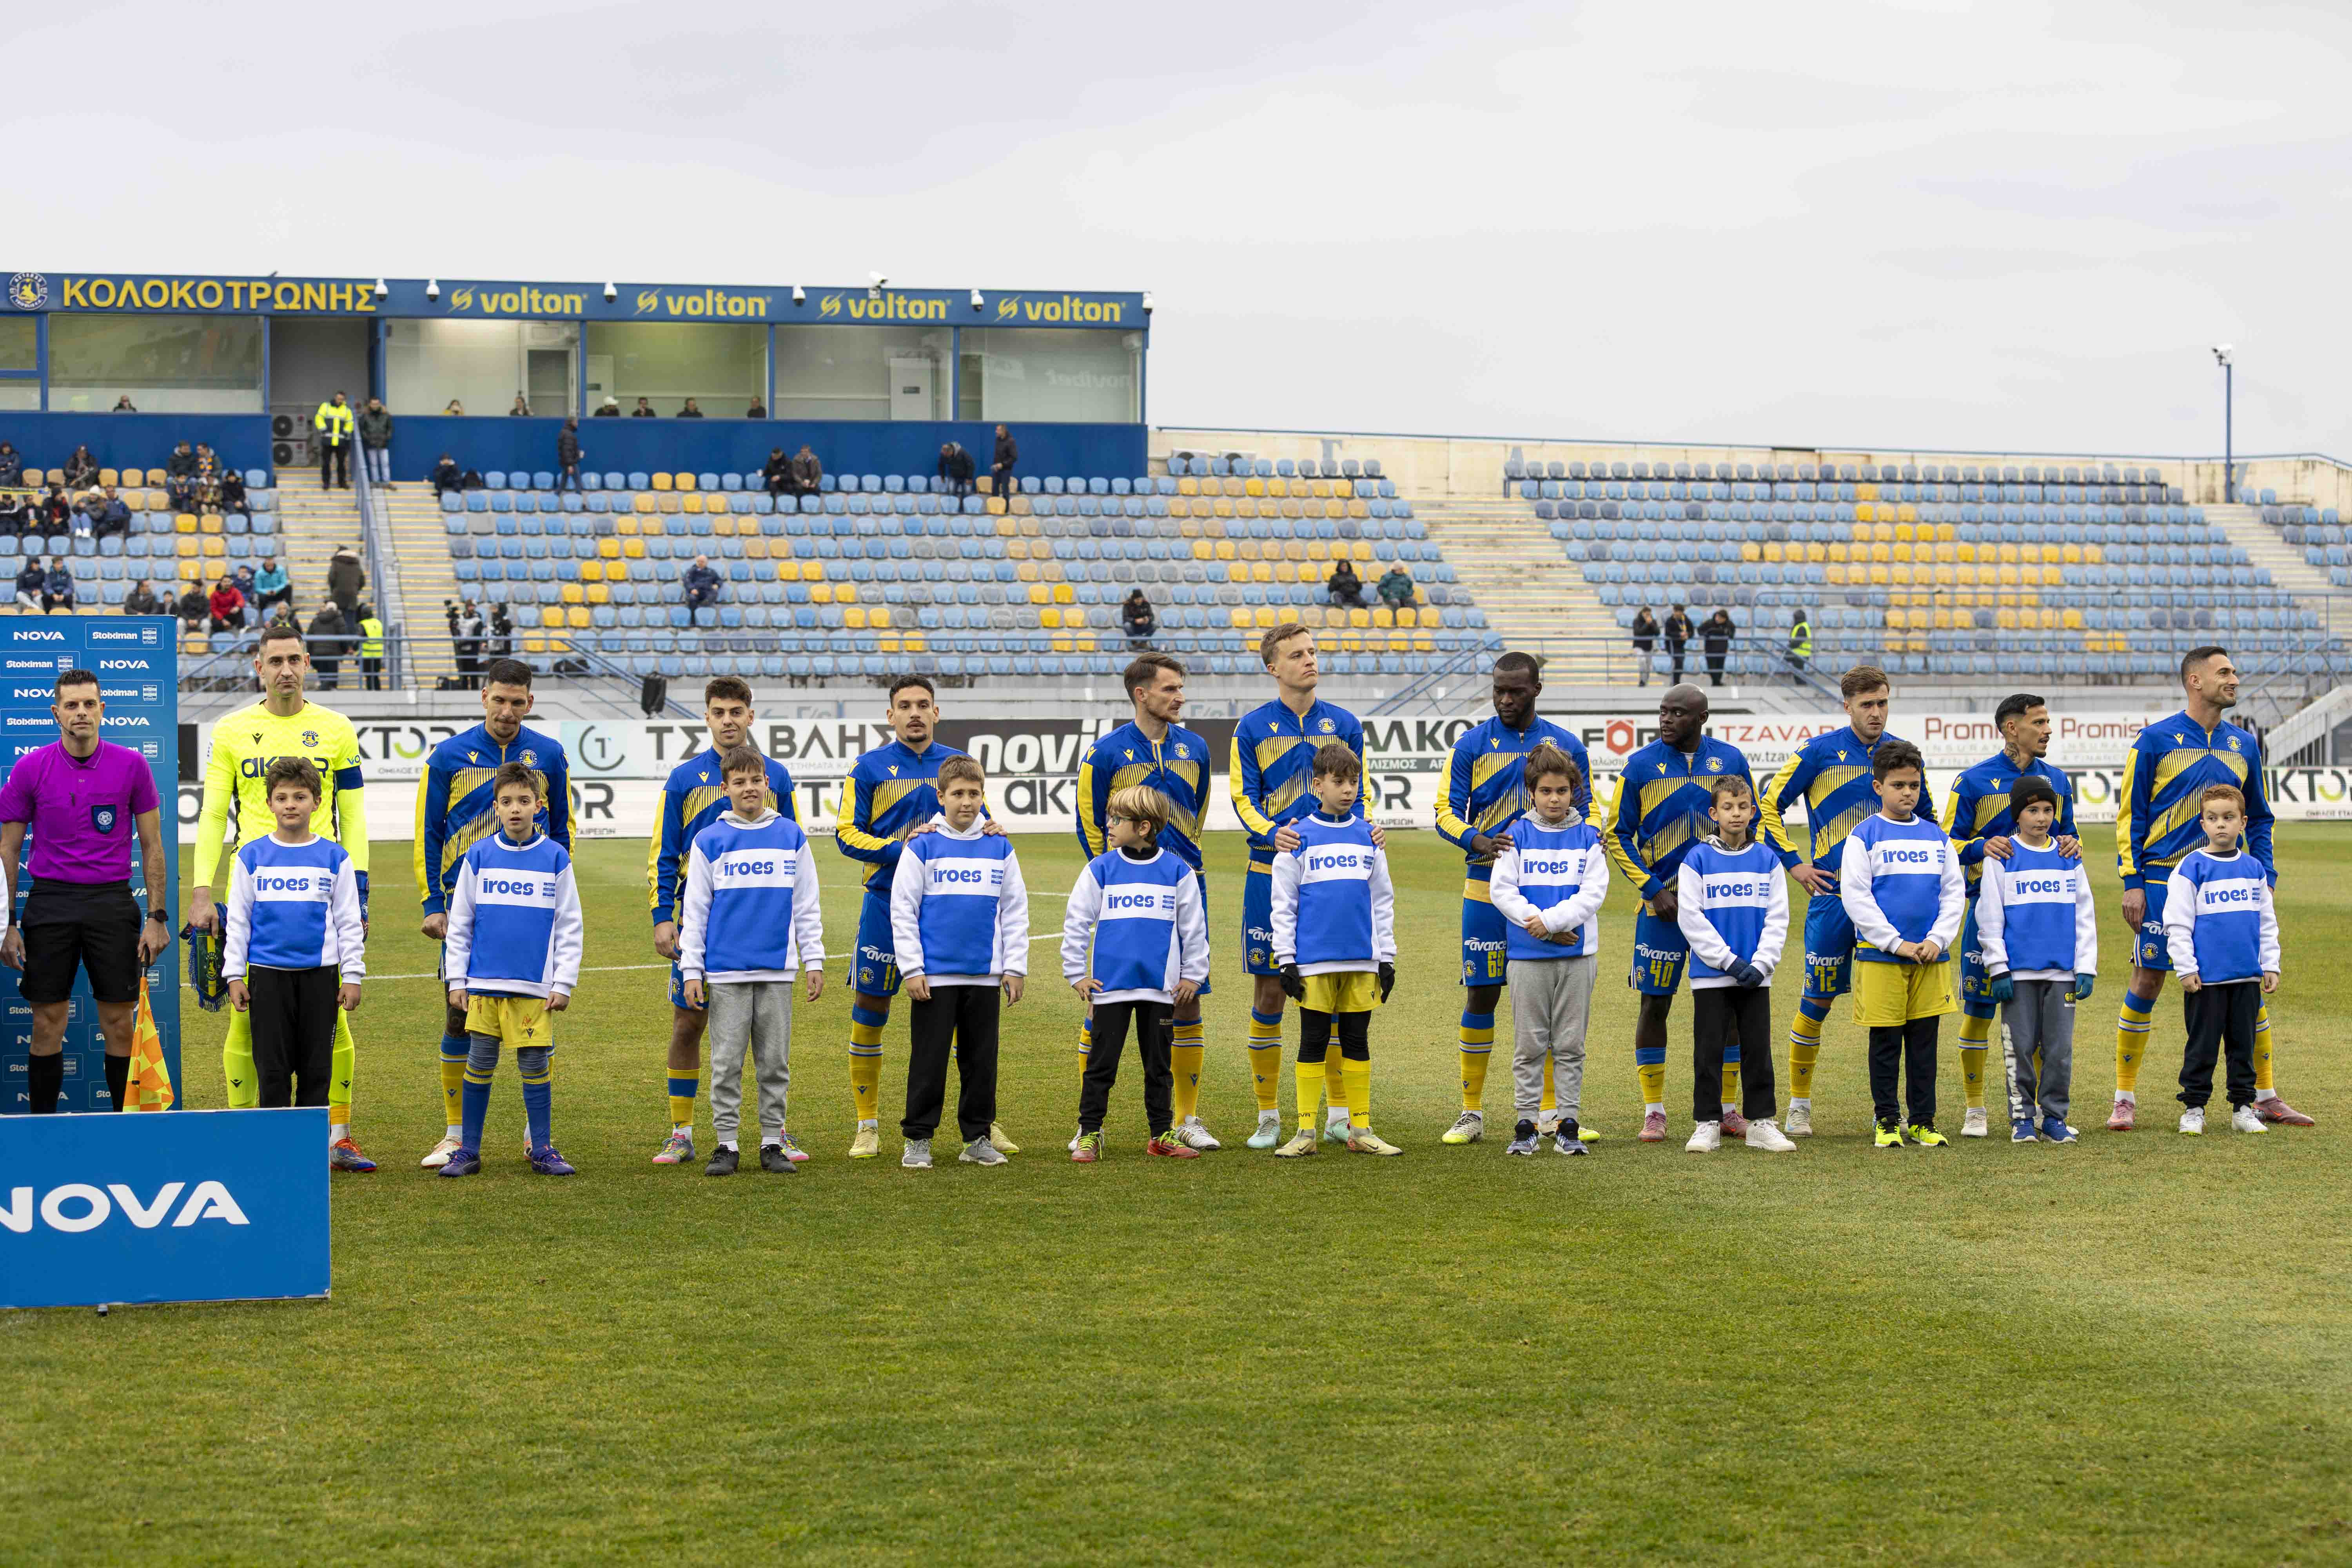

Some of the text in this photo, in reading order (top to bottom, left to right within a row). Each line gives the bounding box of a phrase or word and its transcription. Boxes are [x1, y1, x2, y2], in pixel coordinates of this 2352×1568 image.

[63, 279, 376, 312] ΚΟΛΟΚΟΤΡΩΝΗΣ
[480, 287, 583, 314] volton
[666, 289, 767, 317] volton
[848, 292, 946, 319] volton
[1024, 295, 1121, 322] volton
[13, 631, 65, 641] NOVA
[92, 631, 138, 640] Stoiximan
[100, 660, 150, 669] NOVA
[101, 717, 150, 726] NOVA
[1309, 855, 1357, 871] iroes
[1882, 849, 1929, 863] iroes
[724, 862, 774, 876] iroes
[1524, 859, 1568, 874] iroes
[257, 876, 309, 891] iroes
[934, 869, 982, 883] iroes
[483, 878, 534, 896] iroes
[1706, 883, 1753, 899] iroes
[2016, 880, 2060, 895] iroes
[1108, 895, 1154, 909] iroes
[2205, 889, 2248, 904] iroes
[1640, 945, 1681, 961] avance
[1487, 950, 1505, 978] 69
[1649, 959, 1674, 987] 40
[1815, 966, 1838, 992] 72
